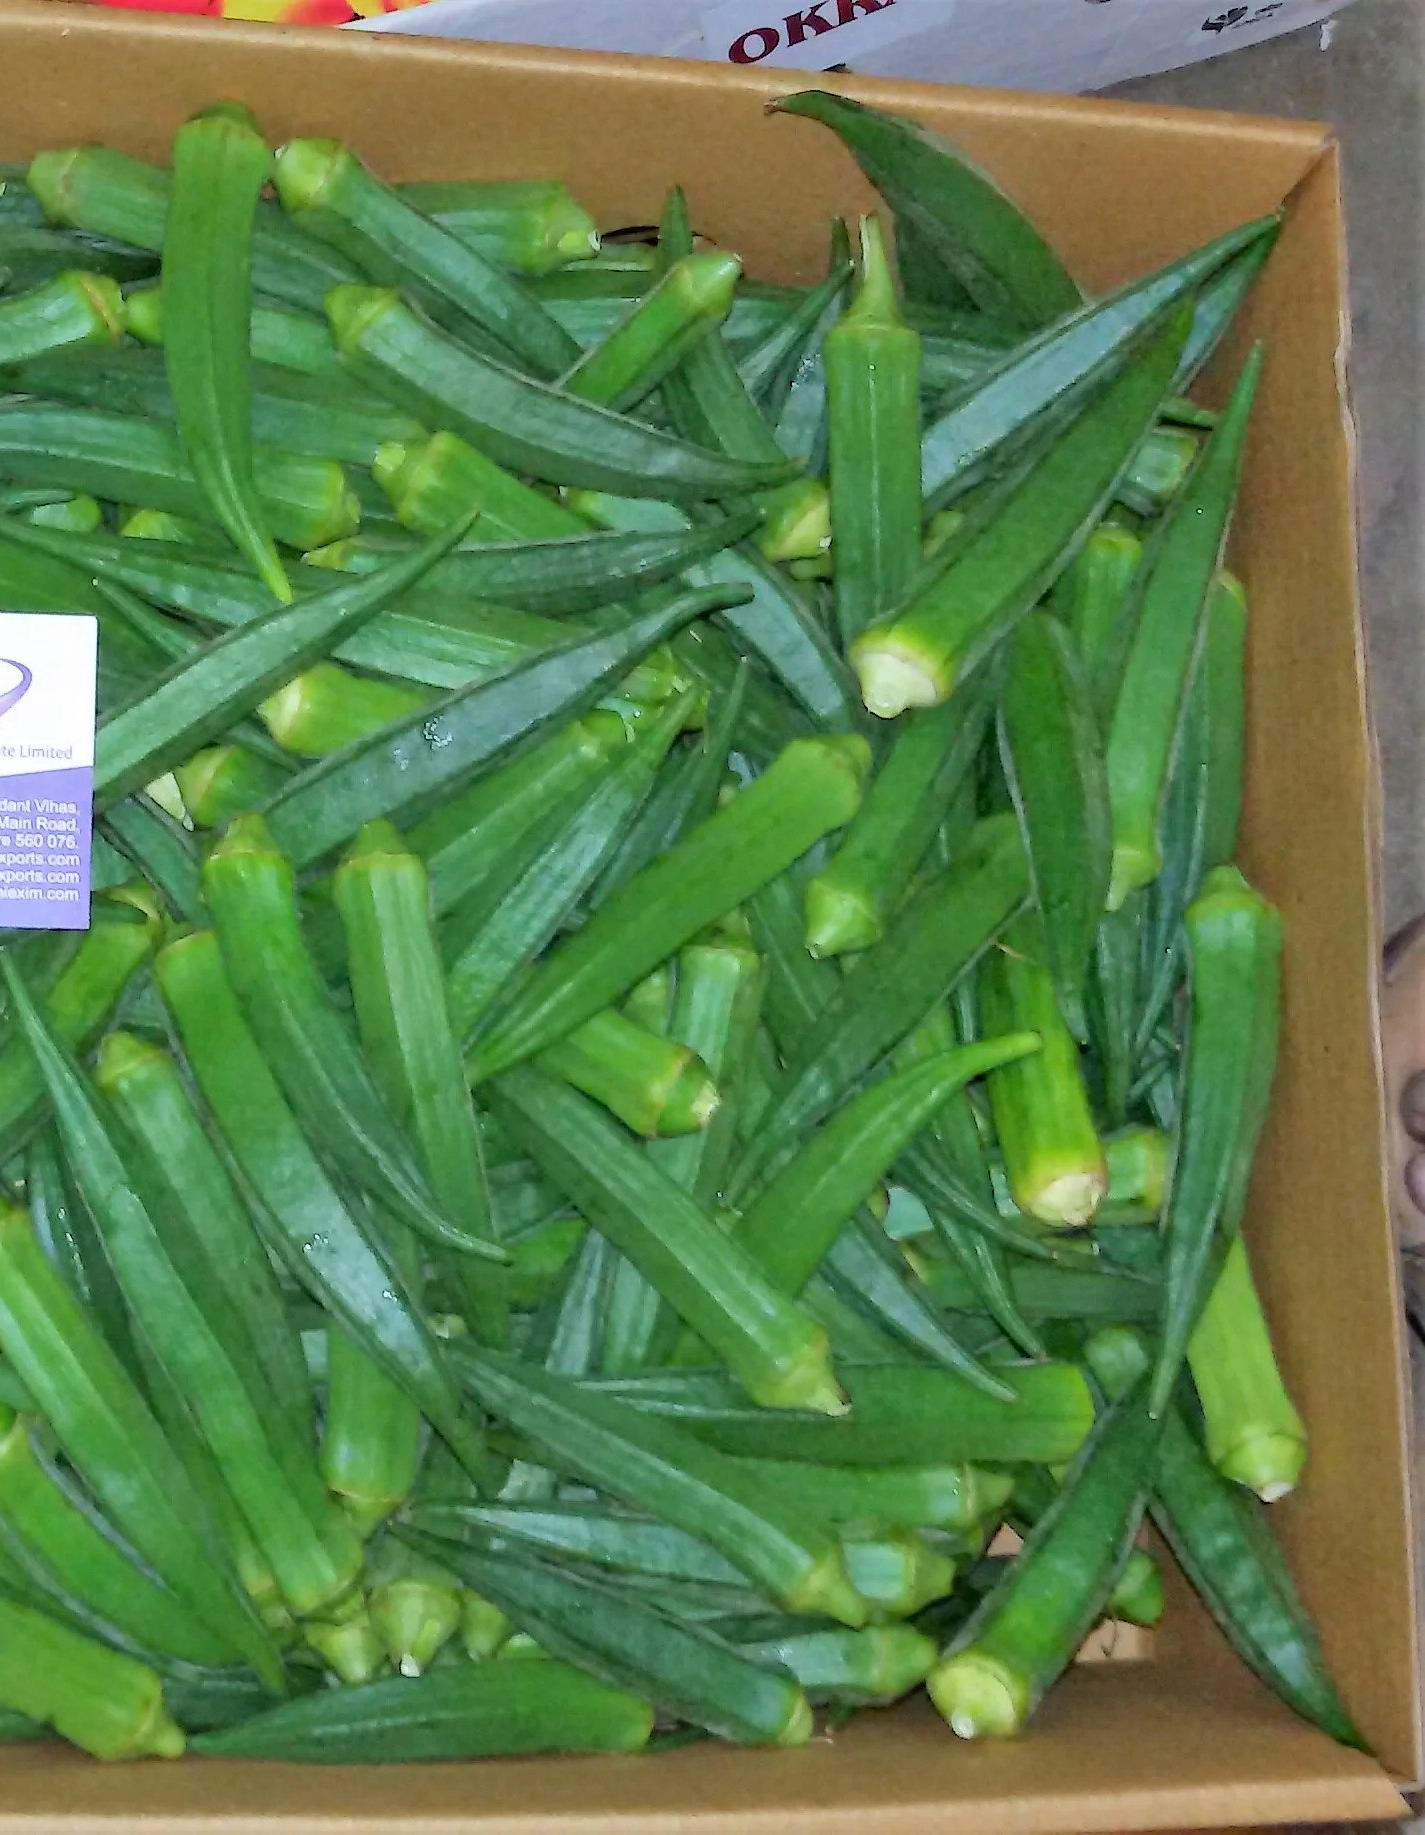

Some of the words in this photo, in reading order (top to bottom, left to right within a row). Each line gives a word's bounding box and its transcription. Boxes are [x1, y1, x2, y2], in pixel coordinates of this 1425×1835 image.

[728, 0, 897, 64] OKR
[20, 743, 73, 760] Limited
[35, 816, 81, 834] Road,
[14, 832, 43, 848] 560
